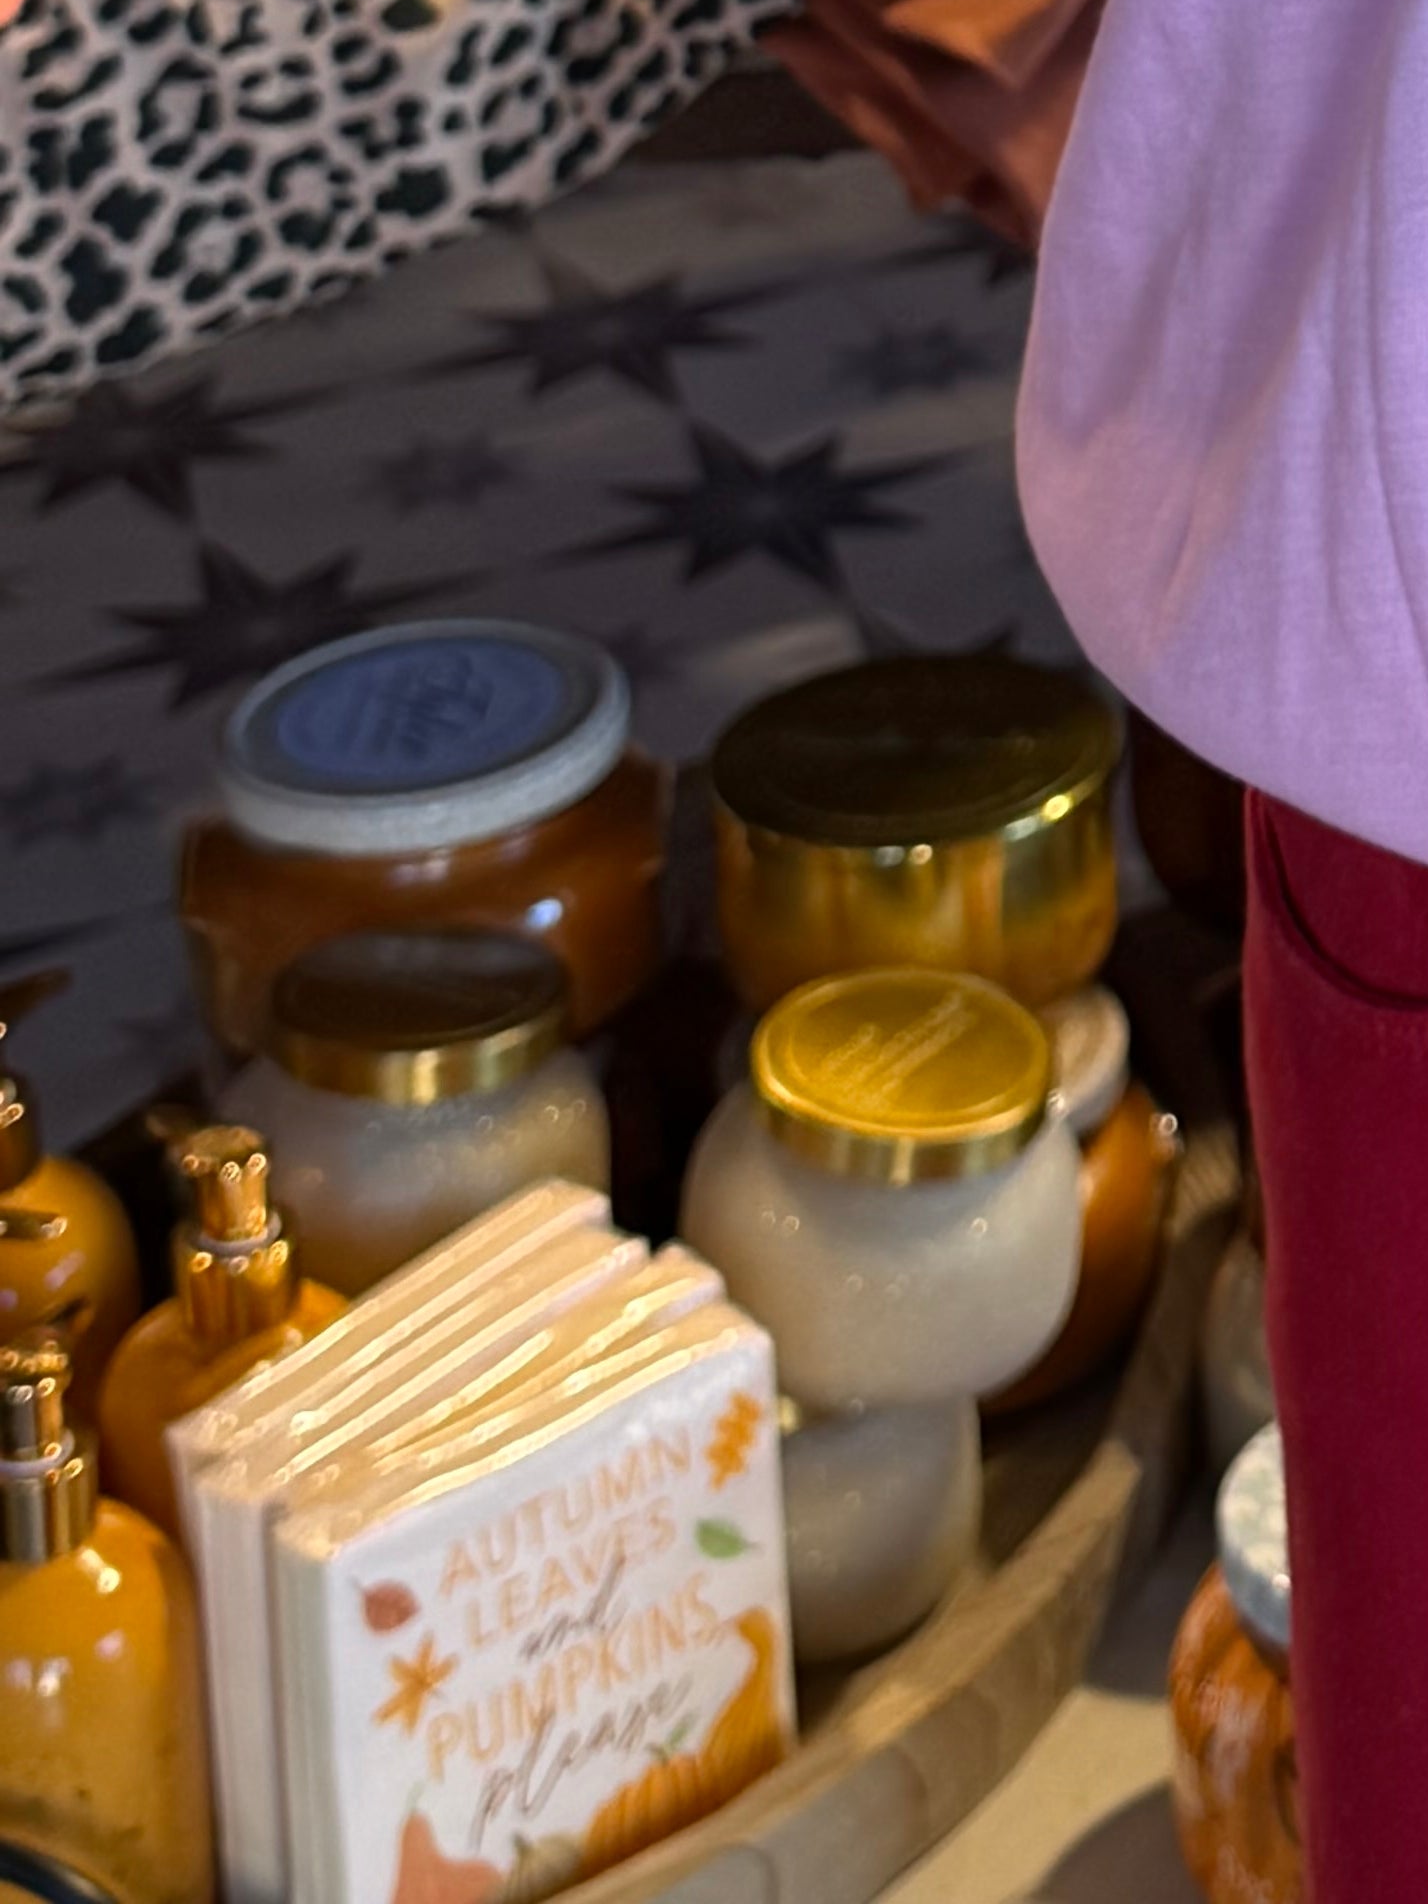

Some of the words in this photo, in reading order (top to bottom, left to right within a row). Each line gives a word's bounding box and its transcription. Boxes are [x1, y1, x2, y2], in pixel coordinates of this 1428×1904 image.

[438, 1426, 694, 1596] AUTUMN
[464, 1496, 678, 1650] LEAVES
[468, 1672, 694, 1854] please
